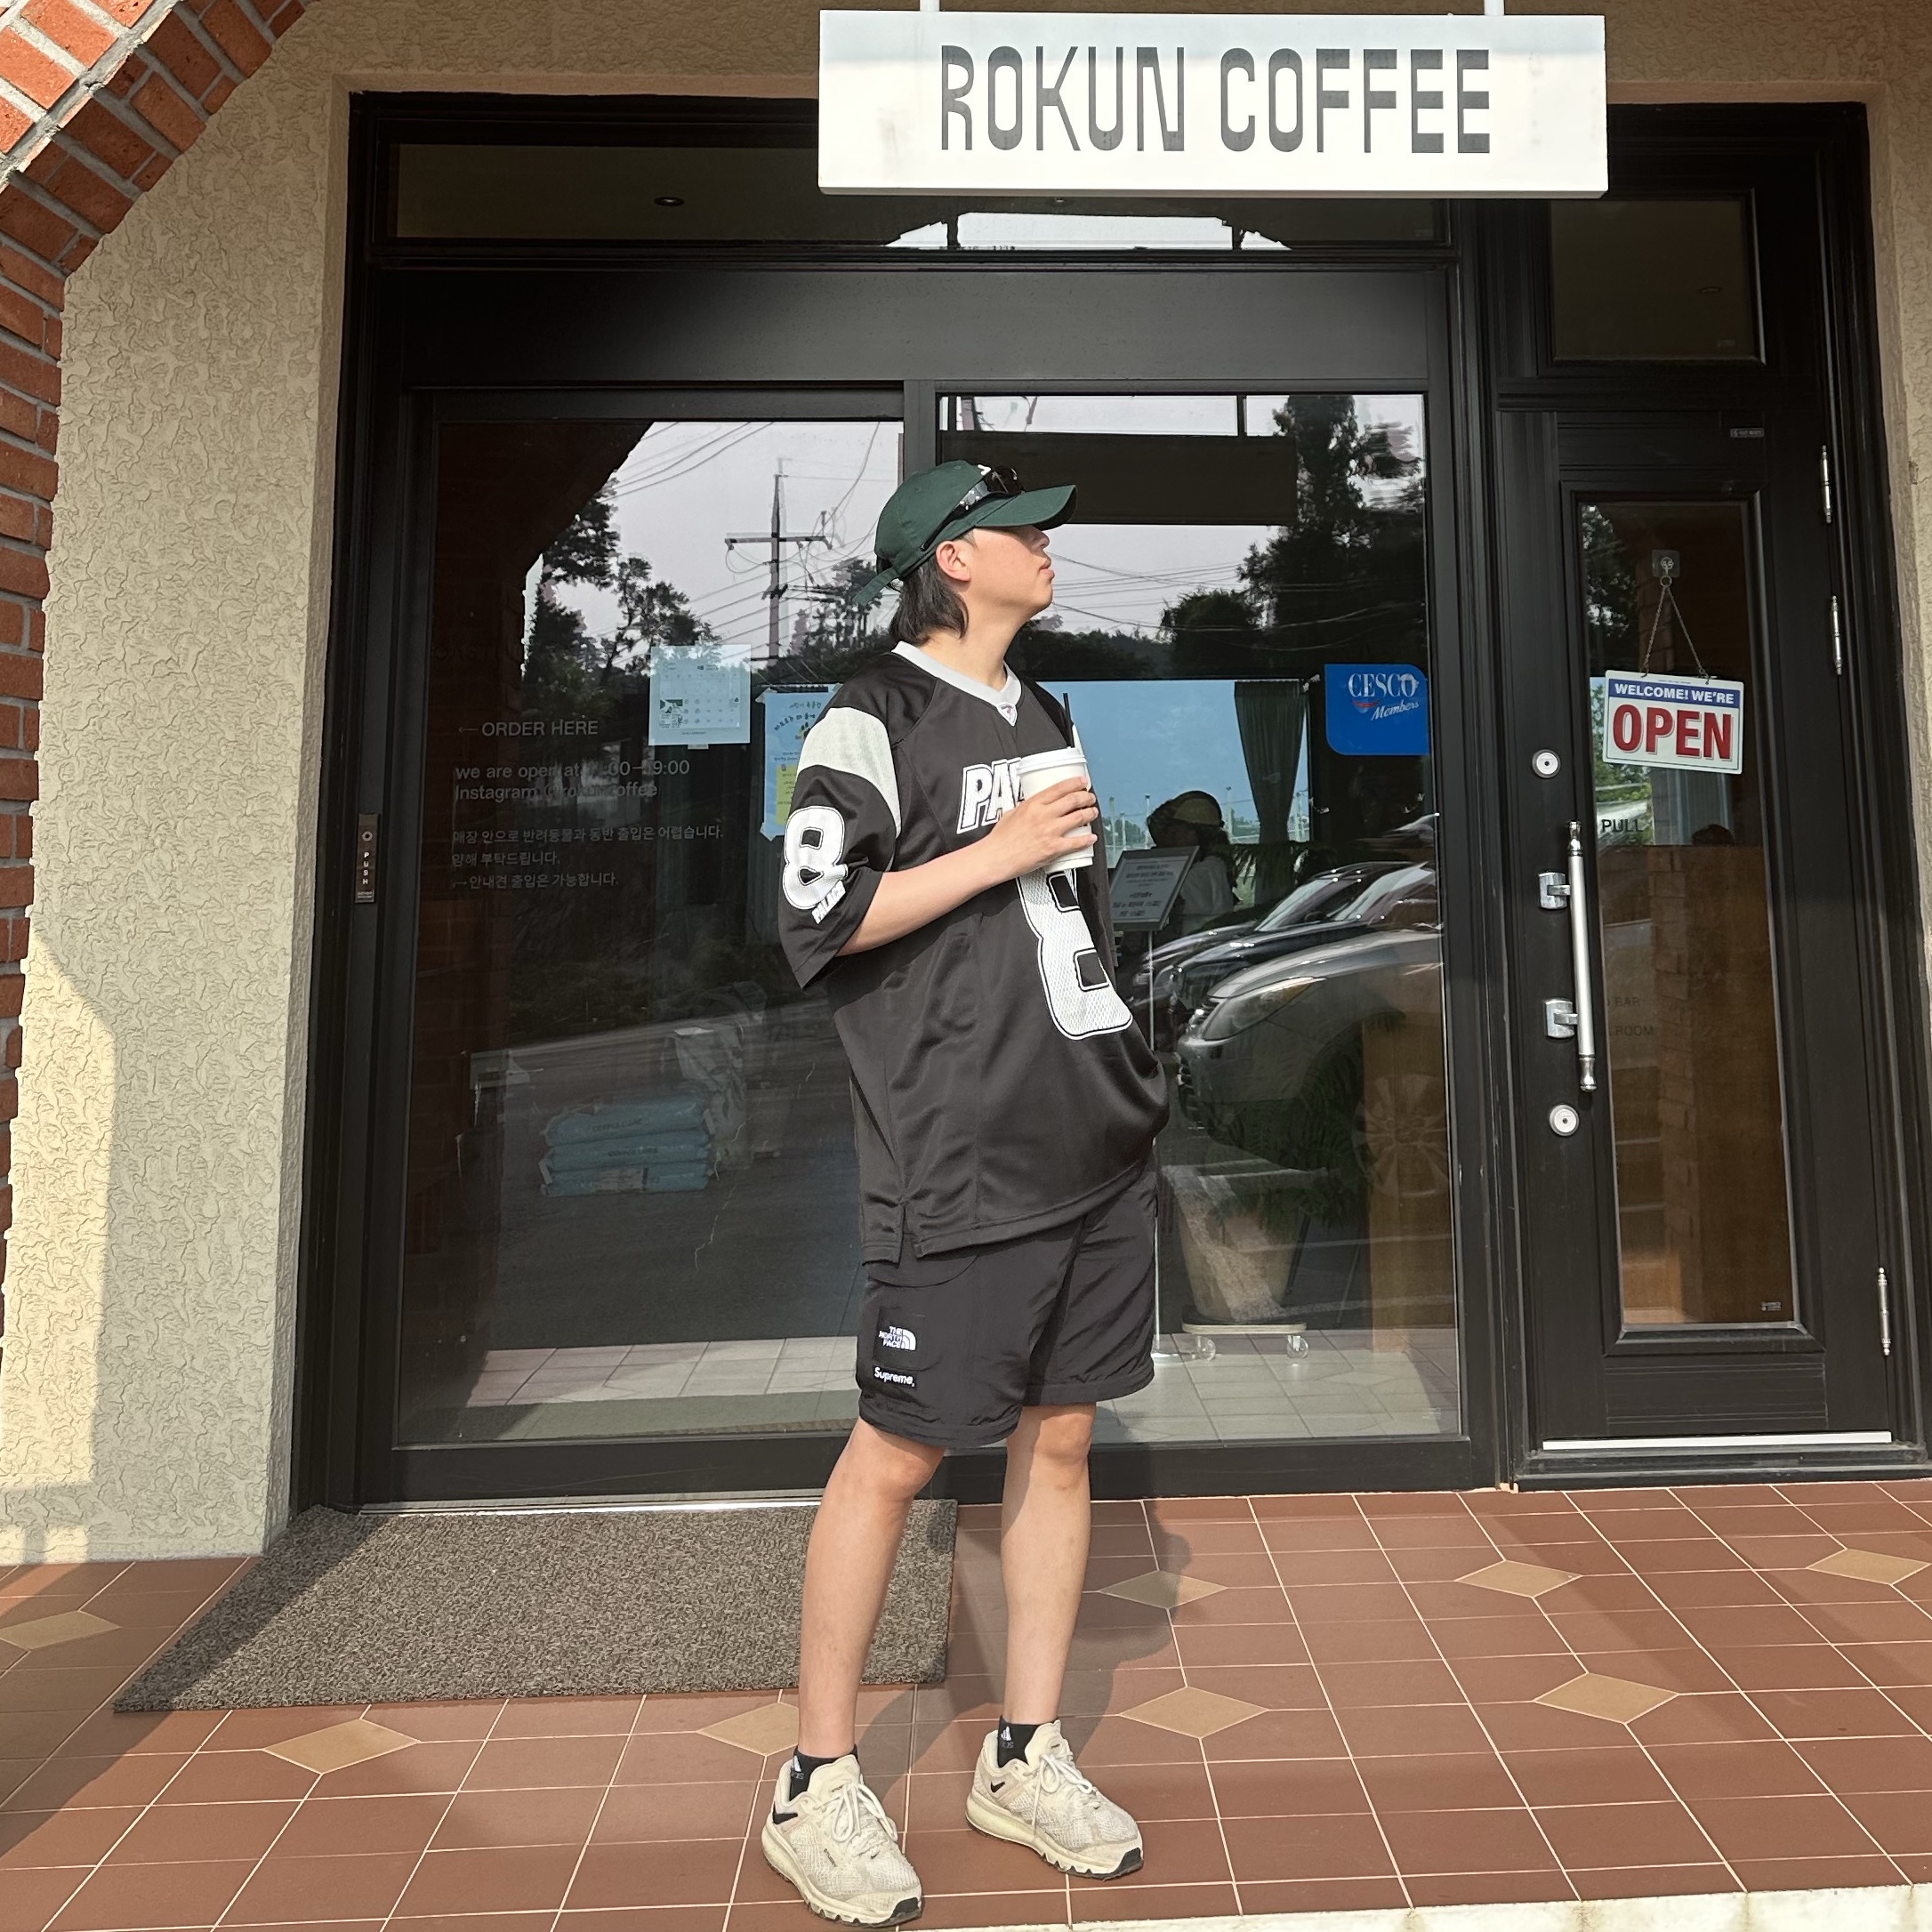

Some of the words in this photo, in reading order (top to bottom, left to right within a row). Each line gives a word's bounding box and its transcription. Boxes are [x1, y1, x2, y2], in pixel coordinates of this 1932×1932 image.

[941, 44, 1185, 152] ROKUN
[1220, 47, 1491, 154] COFFEE
[1348, 673, 1419, 697] CESCO
[1614, 683, 1689, 700] WELCOME!
[1692, 690, 1735, 704] WE'RE
[1371, 699, 1420, 721] Members
[481, 721, 546, 737] ORDER
[551, 720, 599, 736] HERE
[1613, 704, 1734, 761] OPEN
[455, 767, 480, 780] we
[487, 766, 513, 779] are
[519, 763, 561, 782] open
[565, 762, 580, 777] at
[455, 785, 539, 803] Instagram
[956, 757, 1025, 834] PAL
[452, 831, 479, 844] 매장
[481, 830, 519, 844] 안으로
[523, 828, 585, 843] 반려동물과
[590, 826, 614, 841] 동반
[617, 826, 656, 841] 출입은
[658, 825, 724, 841] 어렵습니다.
[1601, 818, 1645, 833] PULL
[362, 851, 370, 885] PUSH
[452, 853, 478, 867] 양해
[481, 850, 560, 866] 부탁드립니다.
[469, 875, 508, 890] 안내견
[511, 873, 550, 889] 출입은
[552, 872, 619, 888] 가능합니다.
[1614, 996, 1641, 1007] BAR
[1615, 1025, 1654, 1036] ROOM
[890, 1325, 903, 1334] THE
[873, 1366, 914, 1386] Supreme
